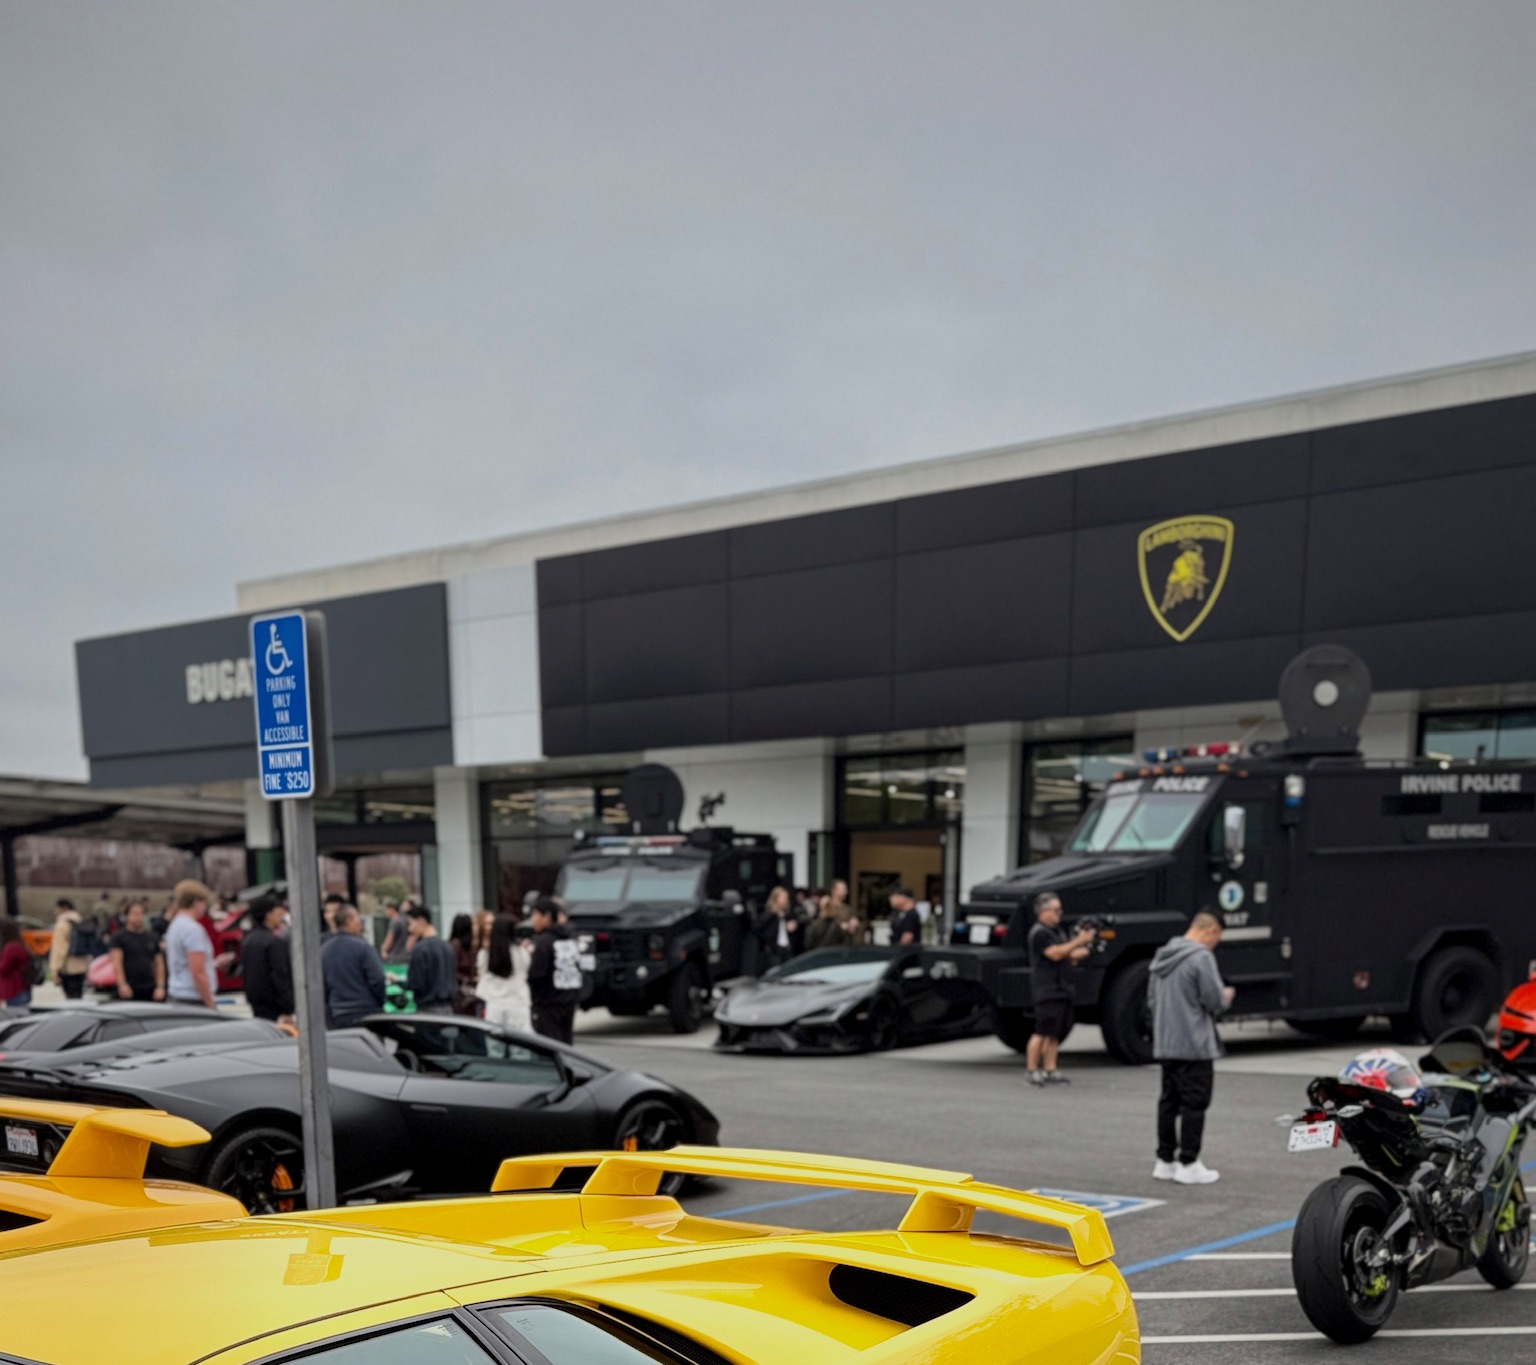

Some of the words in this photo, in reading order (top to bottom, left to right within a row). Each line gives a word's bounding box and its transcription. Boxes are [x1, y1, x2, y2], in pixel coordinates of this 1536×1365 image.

[186, 658, 255, 704] BUGA
[265, 675, 296, 693] PARKING
[272, 693, 291, 709] ONLY
[275, 709, 290, 725] VAN
[264, 725, 305, 743] ACCESSIBLE
[268, 751, 303, 770] MINIMUM
[264, 773, 282, 791] FINE
[286, 770, 309, 790] $250
[1152, 776, 1210, 792] POLICE
[1401, 774, 1459, 794] IRVINE
[1461, 773, 1522, 793] POLICE
